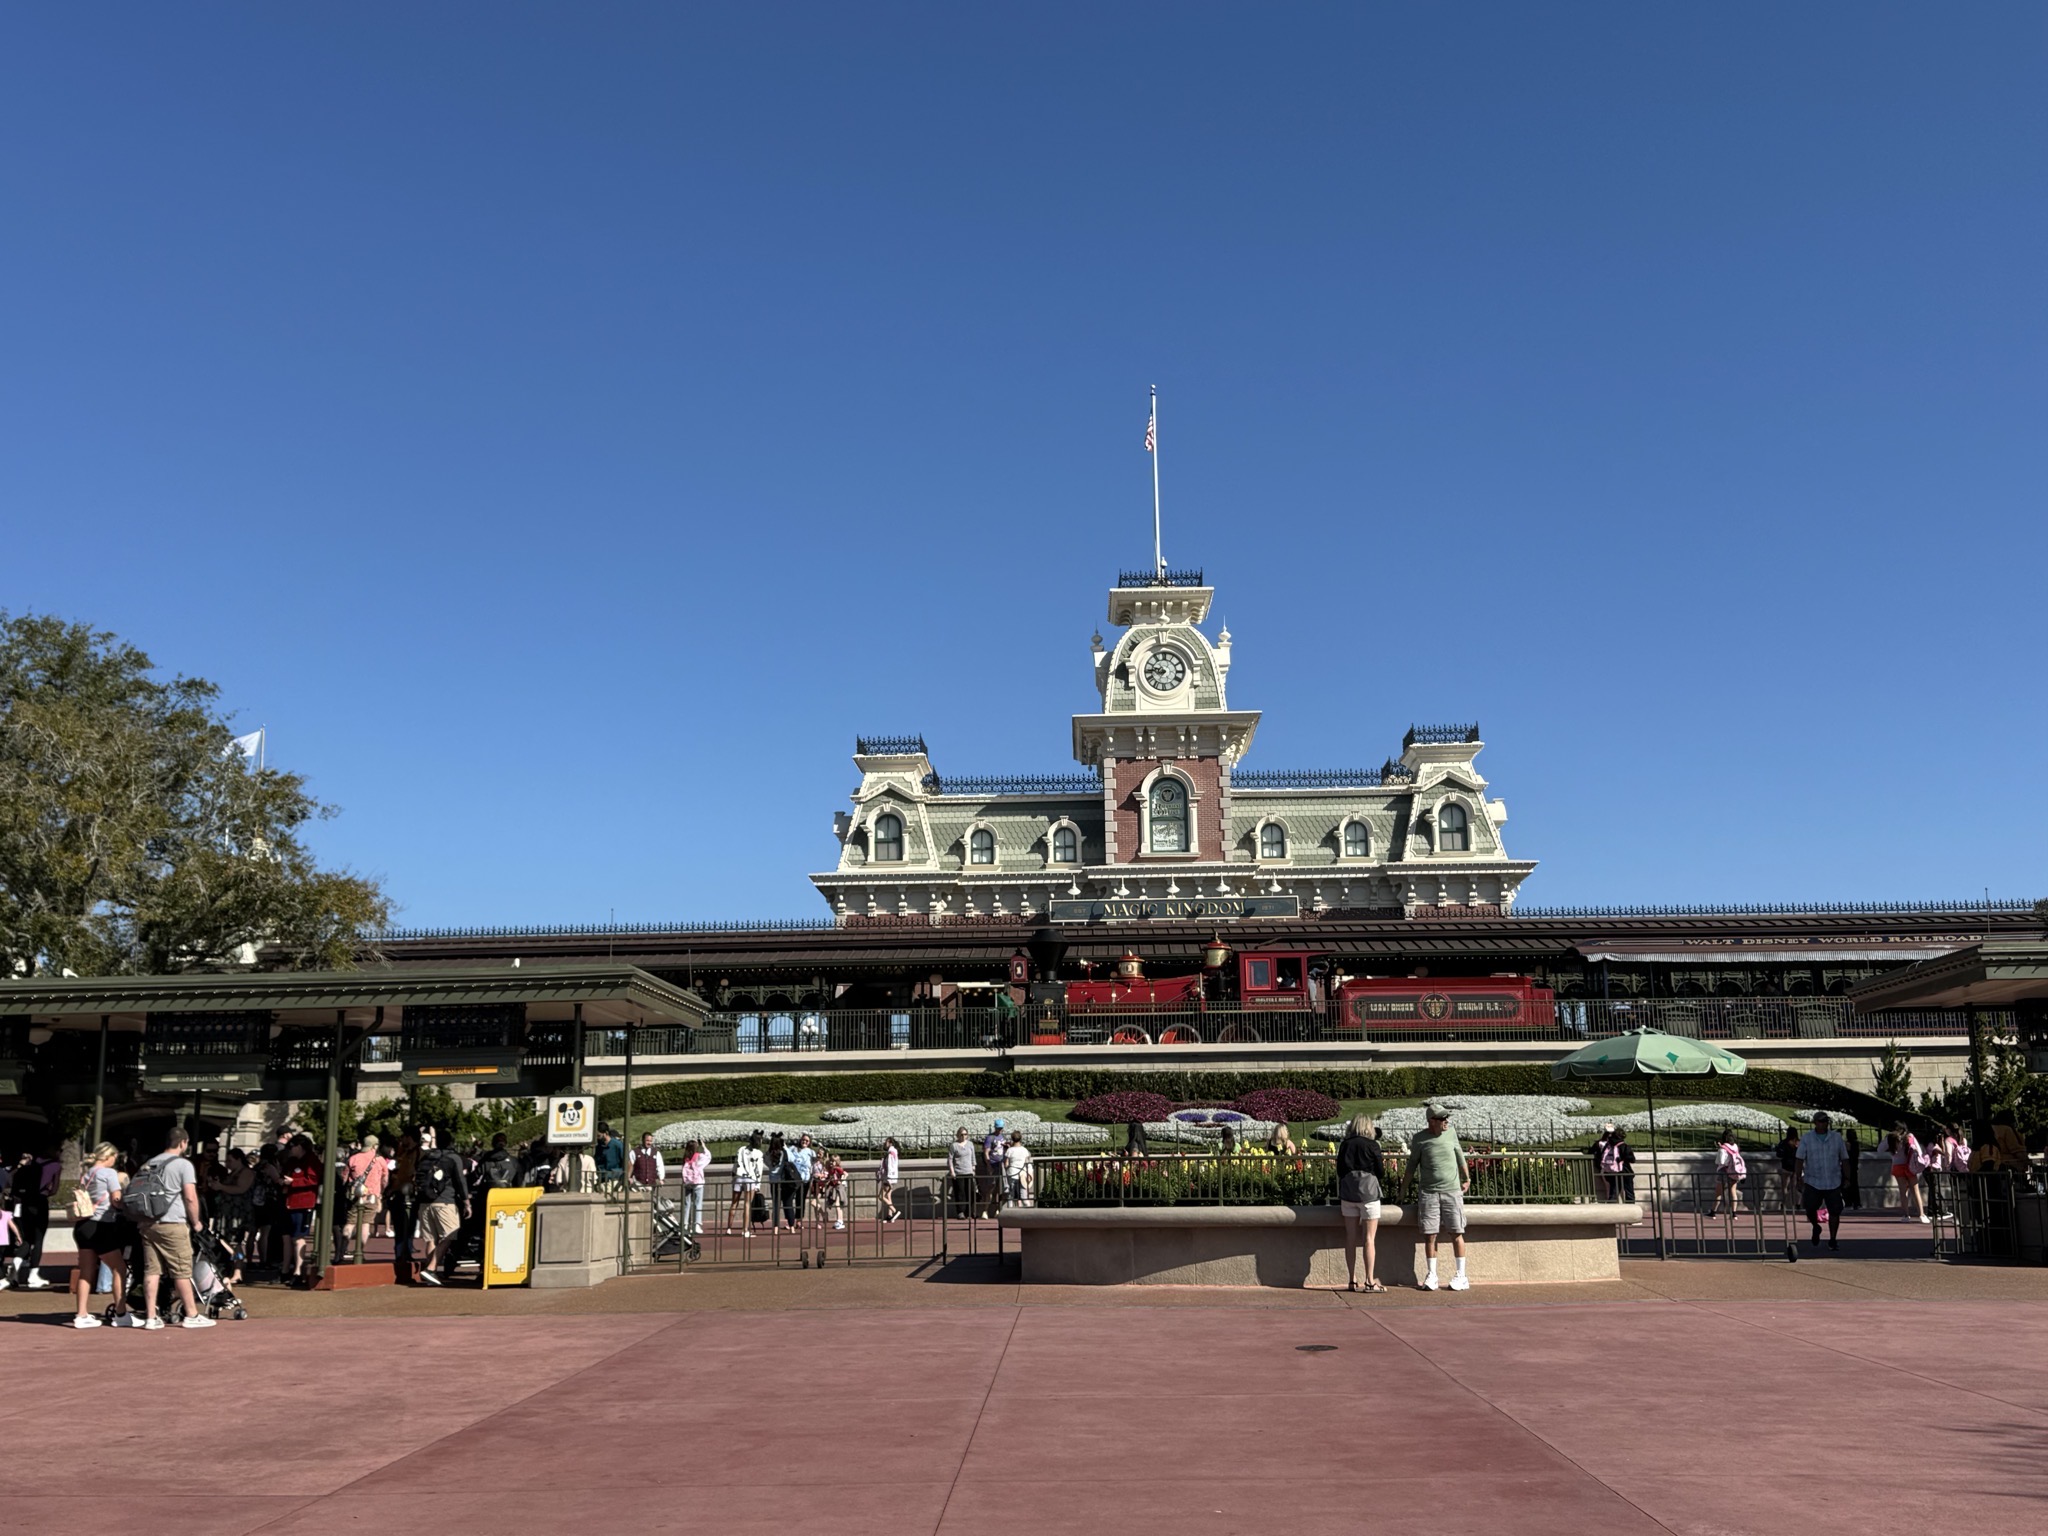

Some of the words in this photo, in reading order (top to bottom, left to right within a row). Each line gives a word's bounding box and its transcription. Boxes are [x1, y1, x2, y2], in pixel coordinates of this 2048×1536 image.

[1103, 902, 1159, 917] MAGIC
[1166, 901, 1246, 916] KINGDOM
[1741, 937, 1811, 945] DISNEY
[1818, 936, 1883, 944] WORLD
[1888, 935, 1982, 943] RAILROAD
